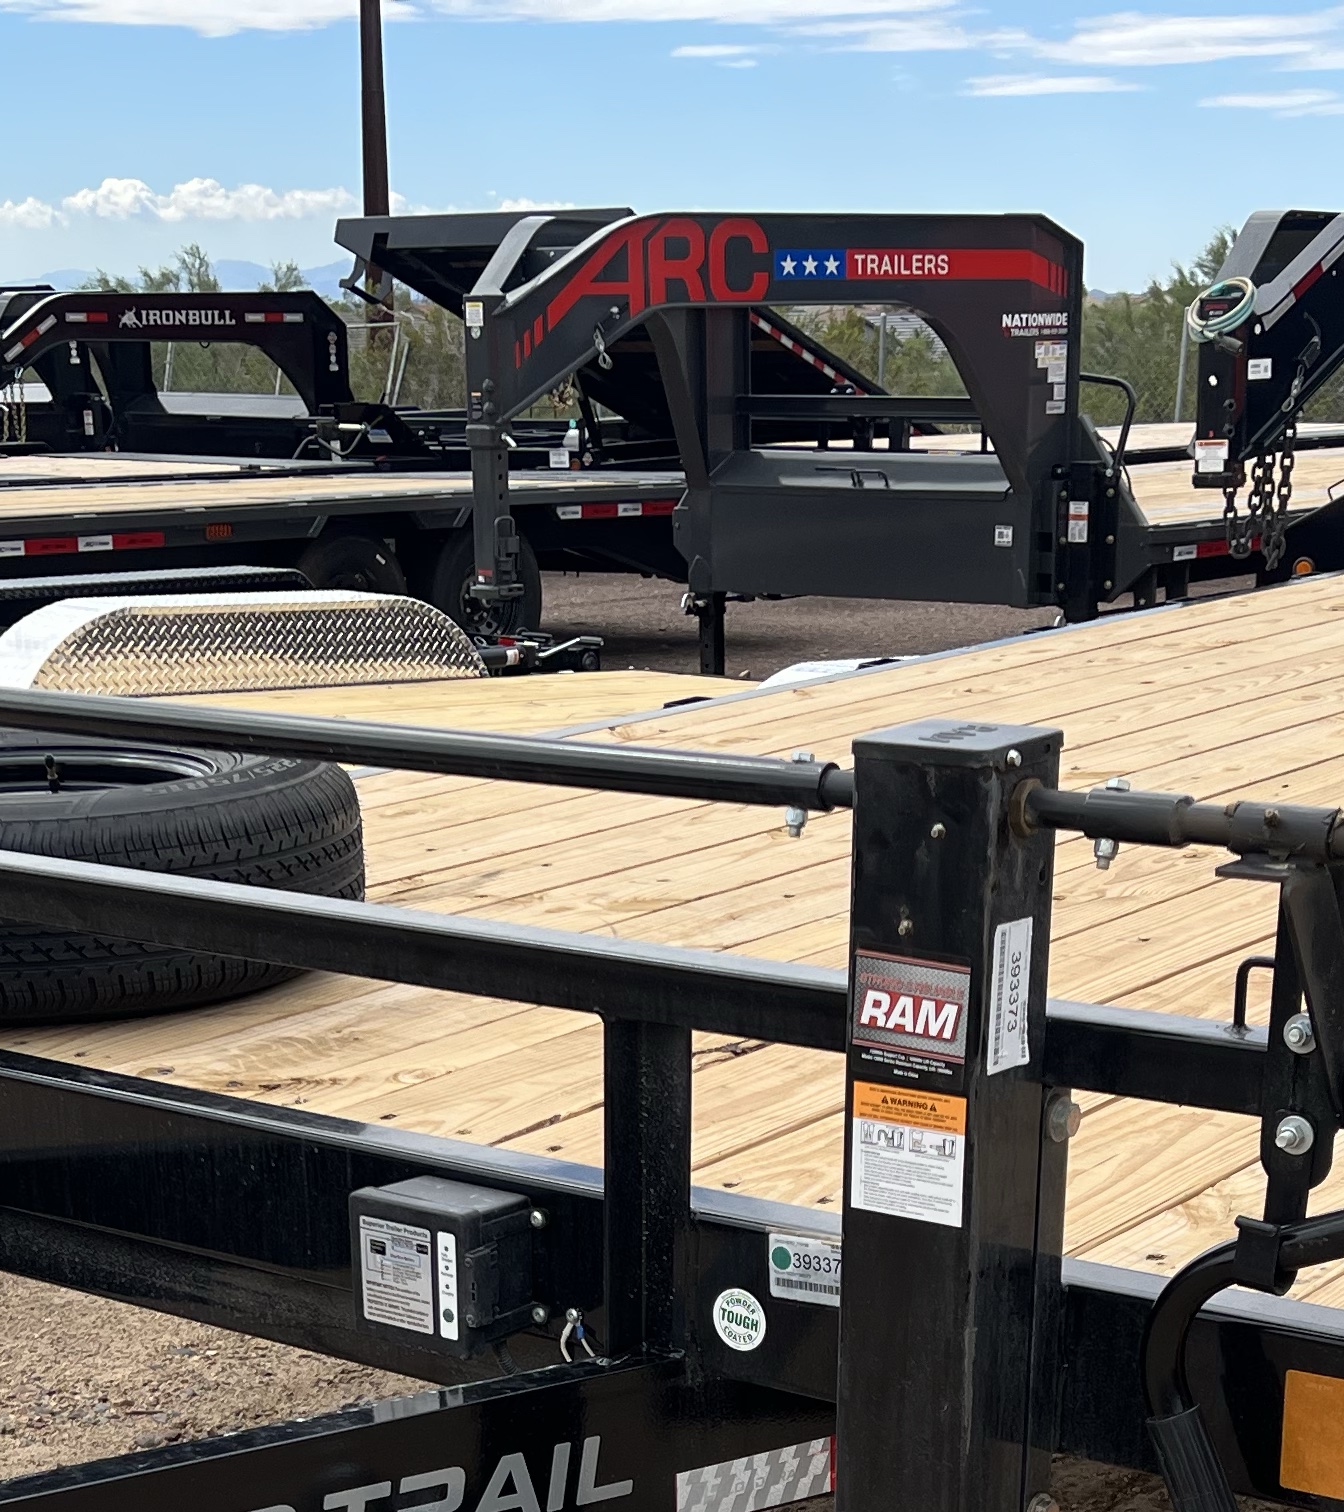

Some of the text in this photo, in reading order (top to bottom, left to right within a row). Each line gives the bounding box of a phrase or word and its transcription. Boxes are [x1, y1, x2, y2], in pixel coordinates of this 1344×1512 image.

[854, 253, 949, 275] TRAILERS
[547, 218, 770, 332] ARC
[141, 310, 236, 325] IRONBULL
[1002, 312, 1068, 327] NATIONWIDE
[1007, 951, 1021, 1033] 393373
[860, 989, 958, 1040] RAM
[890, 1097, 929, 1111] WARNING
[725, 1297, 756, 1315] POWDER
[720, 1307, 759, 1332] TOUGH
[723, 1325, 753, 1343] COATED
